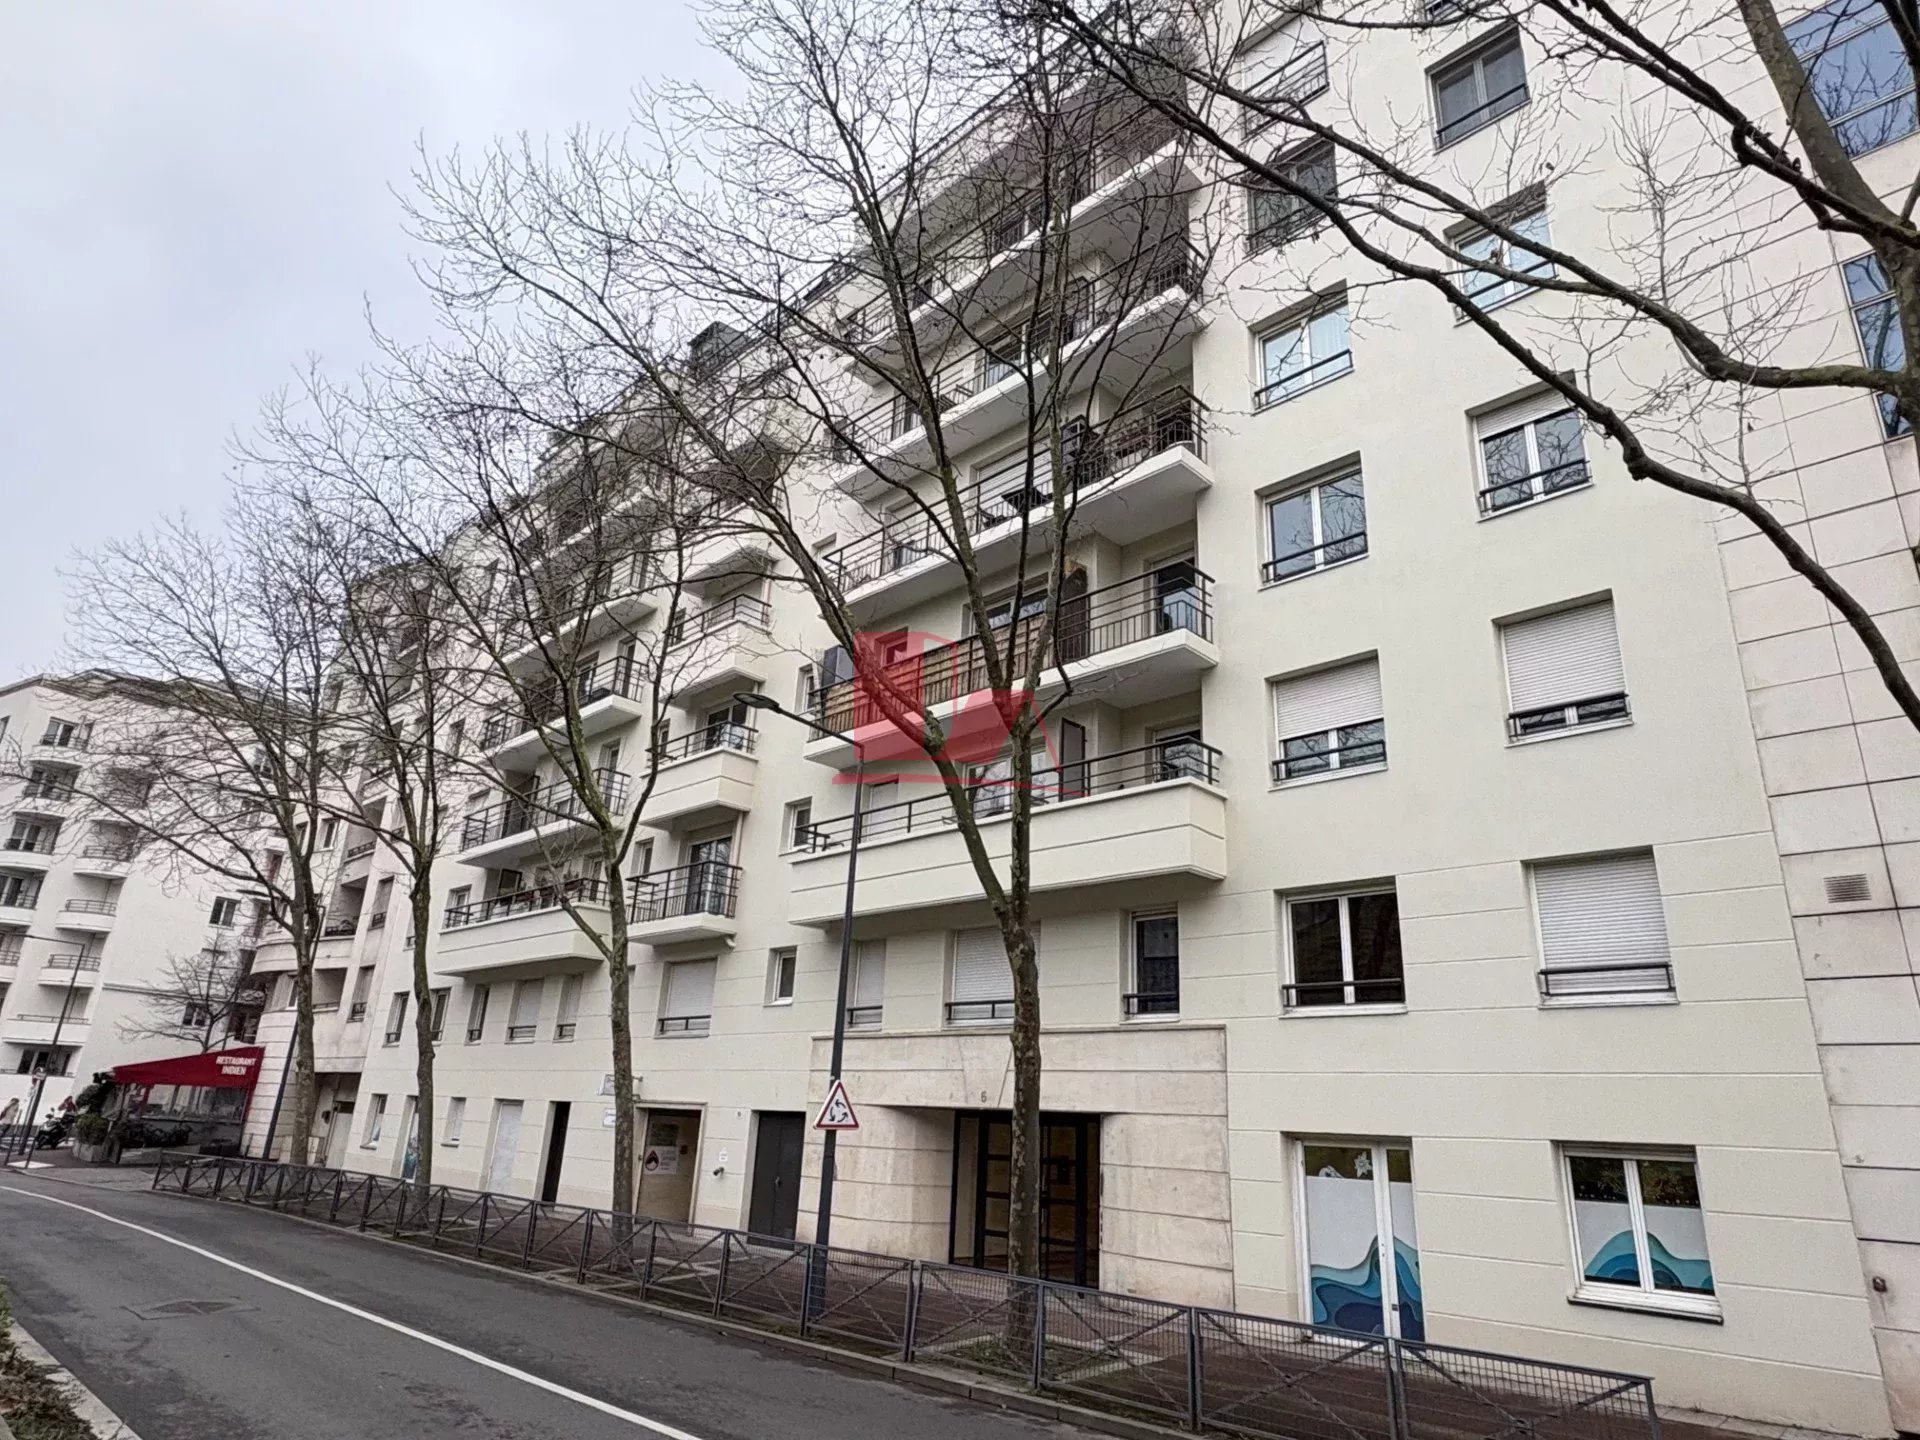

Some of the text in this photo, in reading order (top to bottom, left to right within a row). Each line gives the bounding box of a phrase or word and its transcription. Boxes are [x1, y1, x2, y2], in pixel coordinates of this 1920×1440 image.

[216, 1056, 257, 1066] RESTAURANT
[221, 1065, 247, 1075] INDIEN
[980, 1090, 987, 1104] 6
